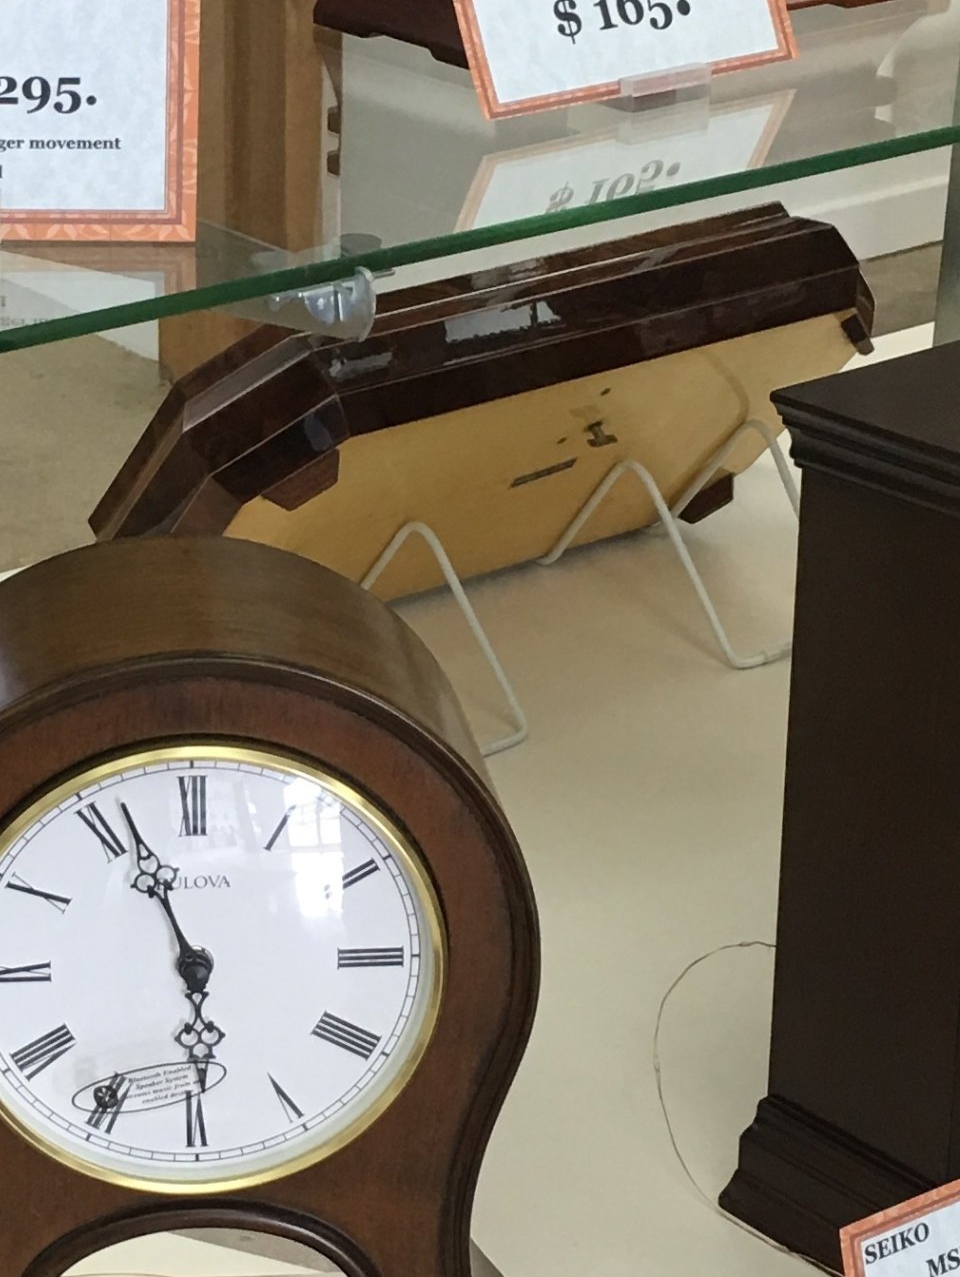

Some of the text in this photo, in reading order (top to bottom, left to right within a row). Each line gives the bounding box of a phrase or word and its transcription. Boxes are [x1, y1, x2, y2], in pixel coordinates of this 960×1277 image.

[29, 136, 121, 150] movement
[157, 874, 231, 891] ULOVA
[865, 1222, 930, 1264] SEIKO
